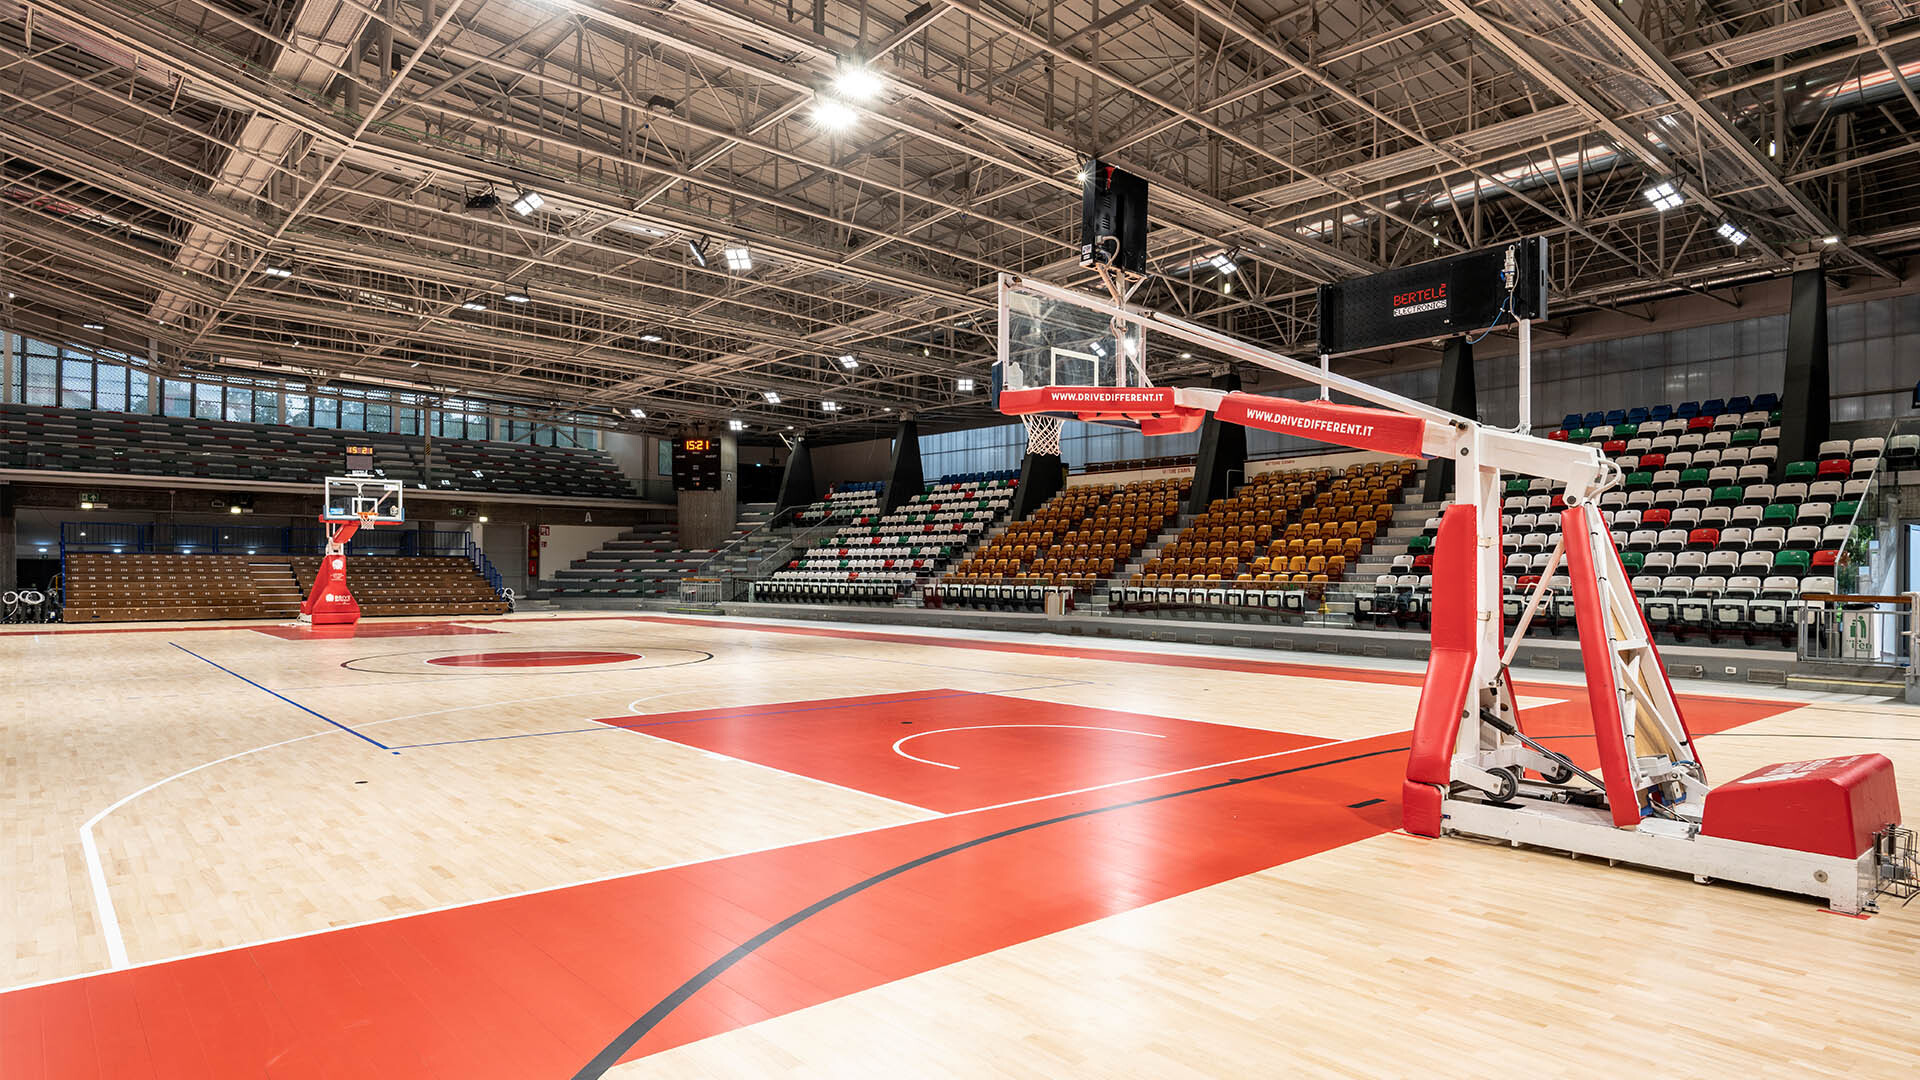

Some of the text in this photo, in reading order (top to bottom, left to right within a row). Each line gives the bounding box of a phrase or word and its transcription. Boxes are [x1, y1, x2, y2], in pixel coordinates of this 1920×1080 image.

[1393, 299, 1447, 317] ELECTRONICS
[1050, 391, 1164, 403] WWW.DRIVEDIFFERENT.IT
[1246, 408, 1374, 437] WWW.DRIVEDIFFERENT.IT
[686, 440, 710, 450] 15:21
[584, 512, 592, 522] A
